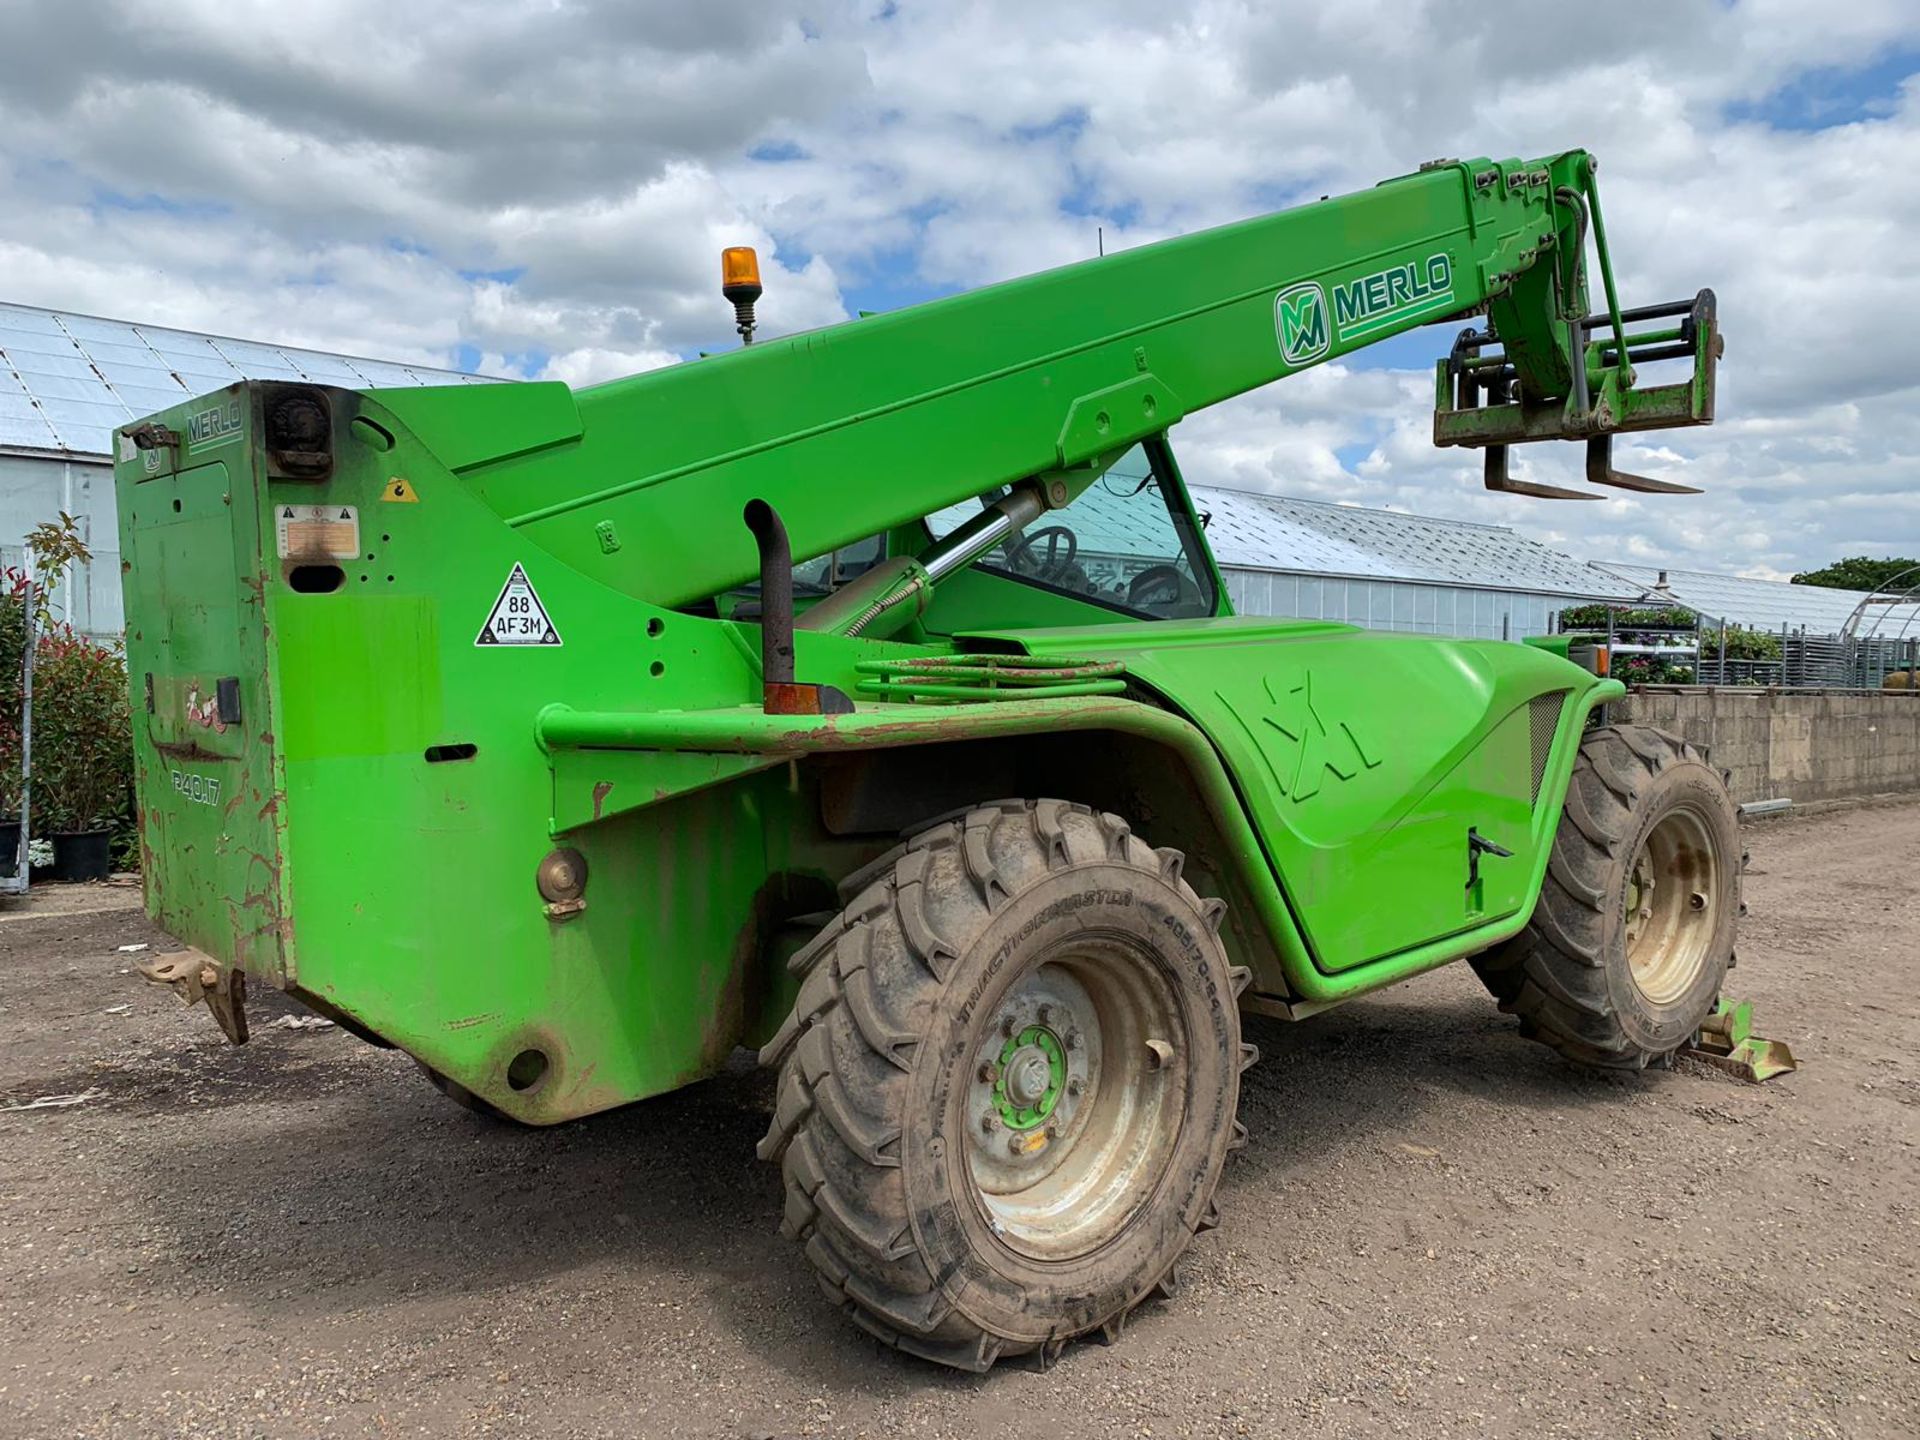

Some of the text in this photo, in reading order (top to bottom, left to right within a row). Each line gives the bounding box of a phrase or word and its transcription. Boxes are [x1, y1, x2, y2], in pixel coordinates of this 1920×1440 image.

[1332, 252, 1452, 325] MERLO
[187, 400, 242, 444] MERLO
[509, 596, 530, 613] 88
[496, 617, 541, 634] AF3M
